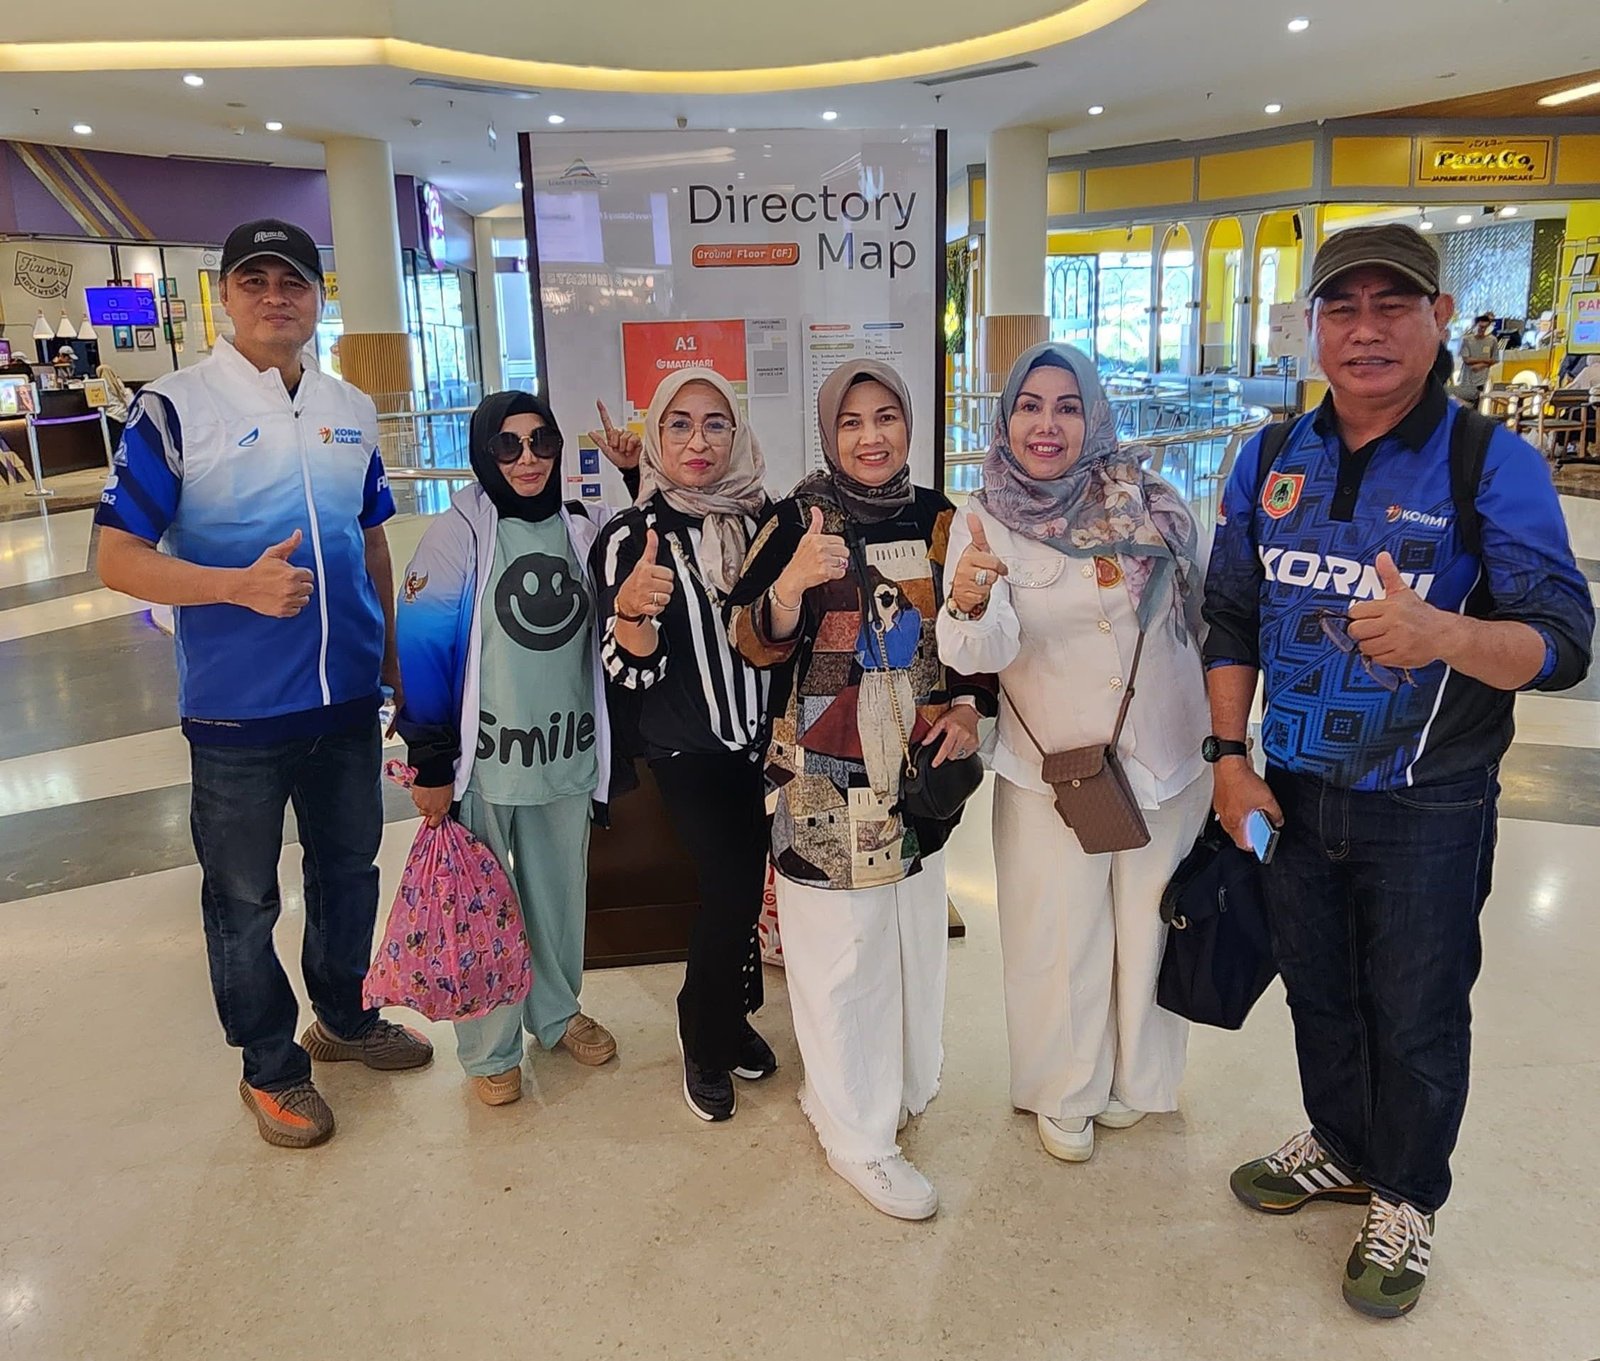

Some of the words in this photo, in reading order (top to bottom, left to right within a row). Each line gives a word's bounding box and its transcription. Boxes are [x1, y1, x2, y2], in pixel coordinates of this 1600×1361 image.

[1499, 174, 1533, 182] PANCAKE
[689, 184, 917, 230] Directory
[697, 248, 732, 260] Ground
[737, 248, 766, 260] Floor
[818, 232, 916, 278] Map
[21, 276, 64, 296] ADVENTURE
[675, 336, 697, 352] A1
[666, 359, 714, 371] MATAHARI
[1402, 510, 1449, 528] KORMI
[476, 711, 596, 767] Smile
